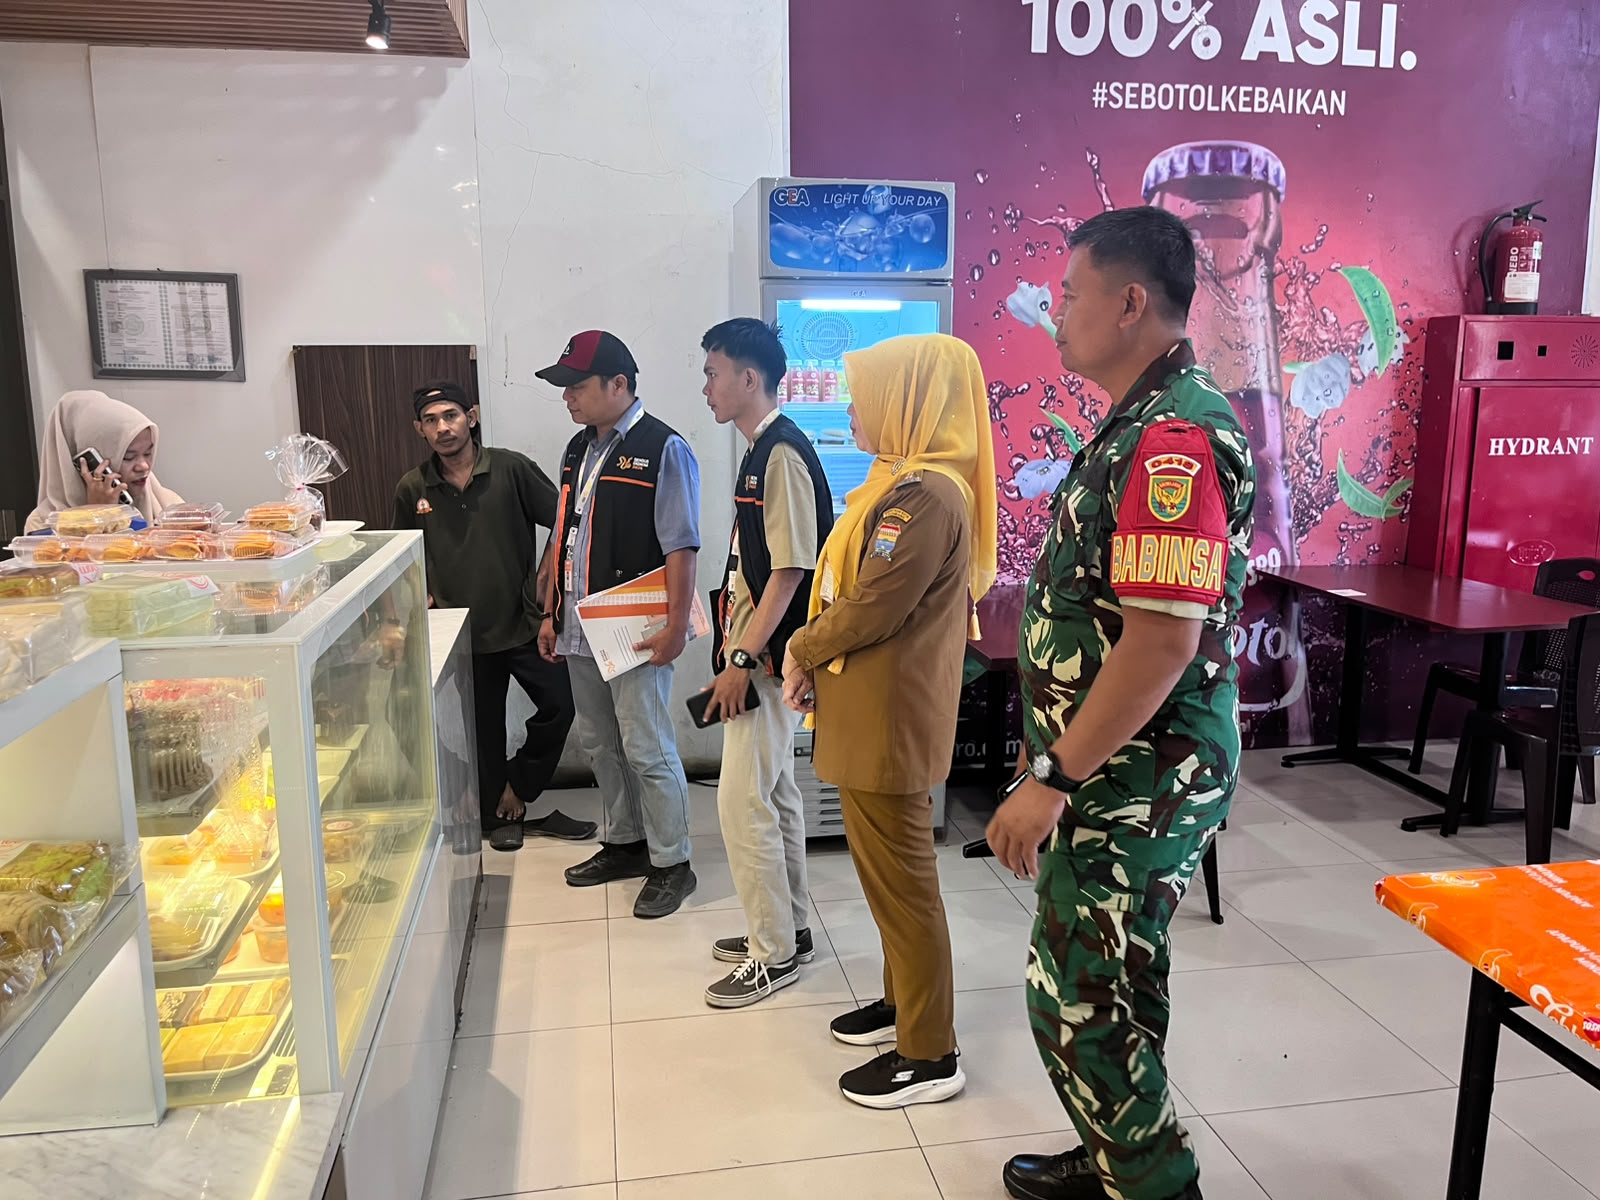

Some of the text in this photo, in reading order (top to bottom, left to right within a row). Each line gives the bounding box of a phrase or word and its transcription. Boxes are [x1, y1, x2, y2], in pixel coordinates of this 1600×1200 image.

[1020, 0, 1417, 71] 100% ASLI.
[1092, 81, 1347, 116] #SEBOTOLKEBAIKAN
[773, 187, 811, 207] GEA
[823, 192, 942, 207] LIGHT UP YOUR DAY
[1488, 436, 1595, 456] HYDRANT
[1111, 534, 1224, 592] BABINSA
